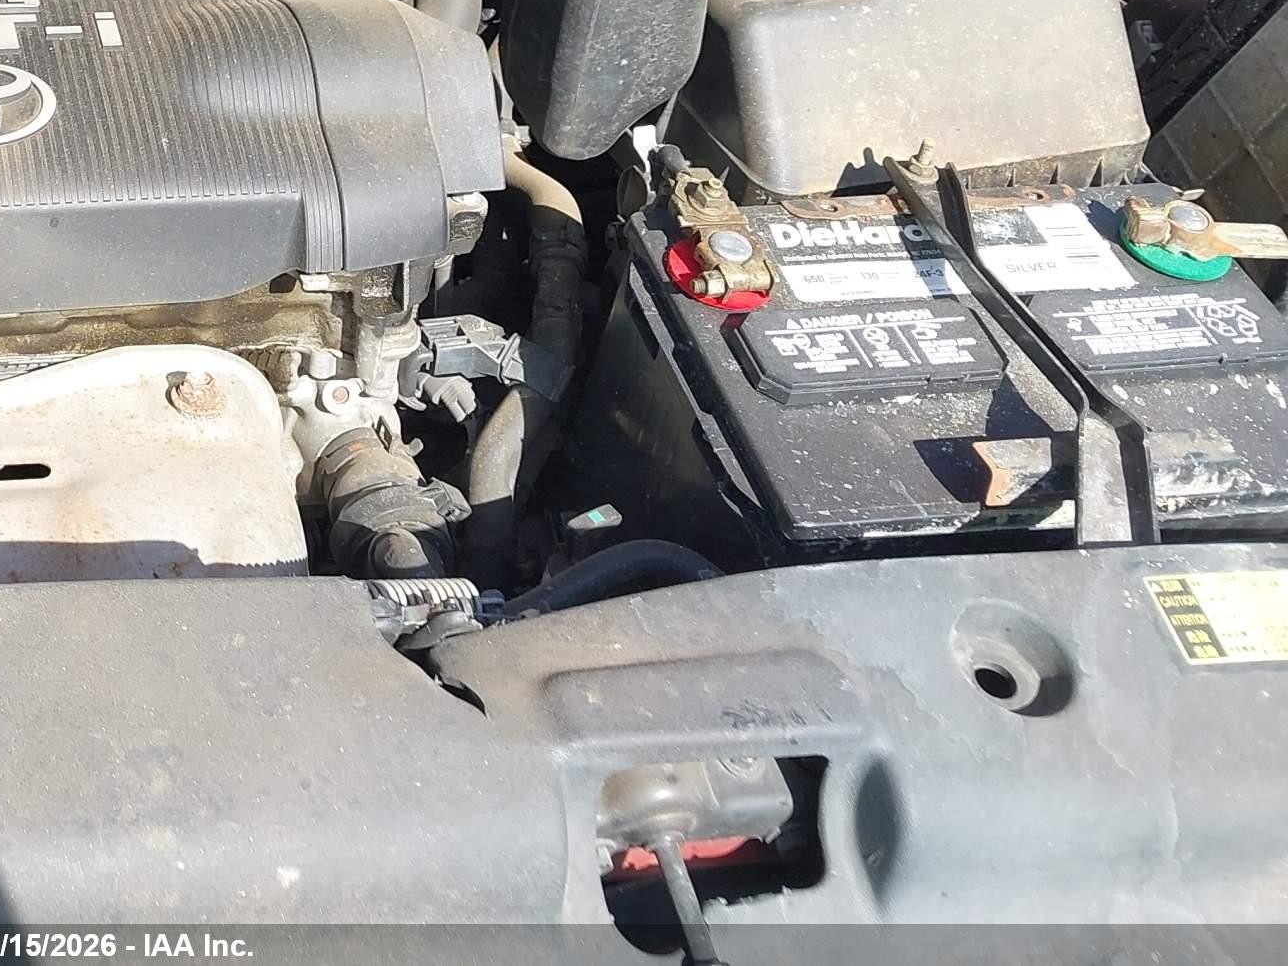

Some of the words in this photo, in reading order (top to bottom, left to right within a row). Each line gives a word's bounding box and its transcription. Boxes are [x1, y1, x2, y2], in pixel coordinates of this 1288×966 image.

[1006, 262, 1058, 273] SILVER
[800, 314, 864, 328] DANGER
[875, 309, 935, 322] POISON
[1159, 594, 1200, 608] CAUTION
[1169, 612, 1209, 627] ATTENTION
